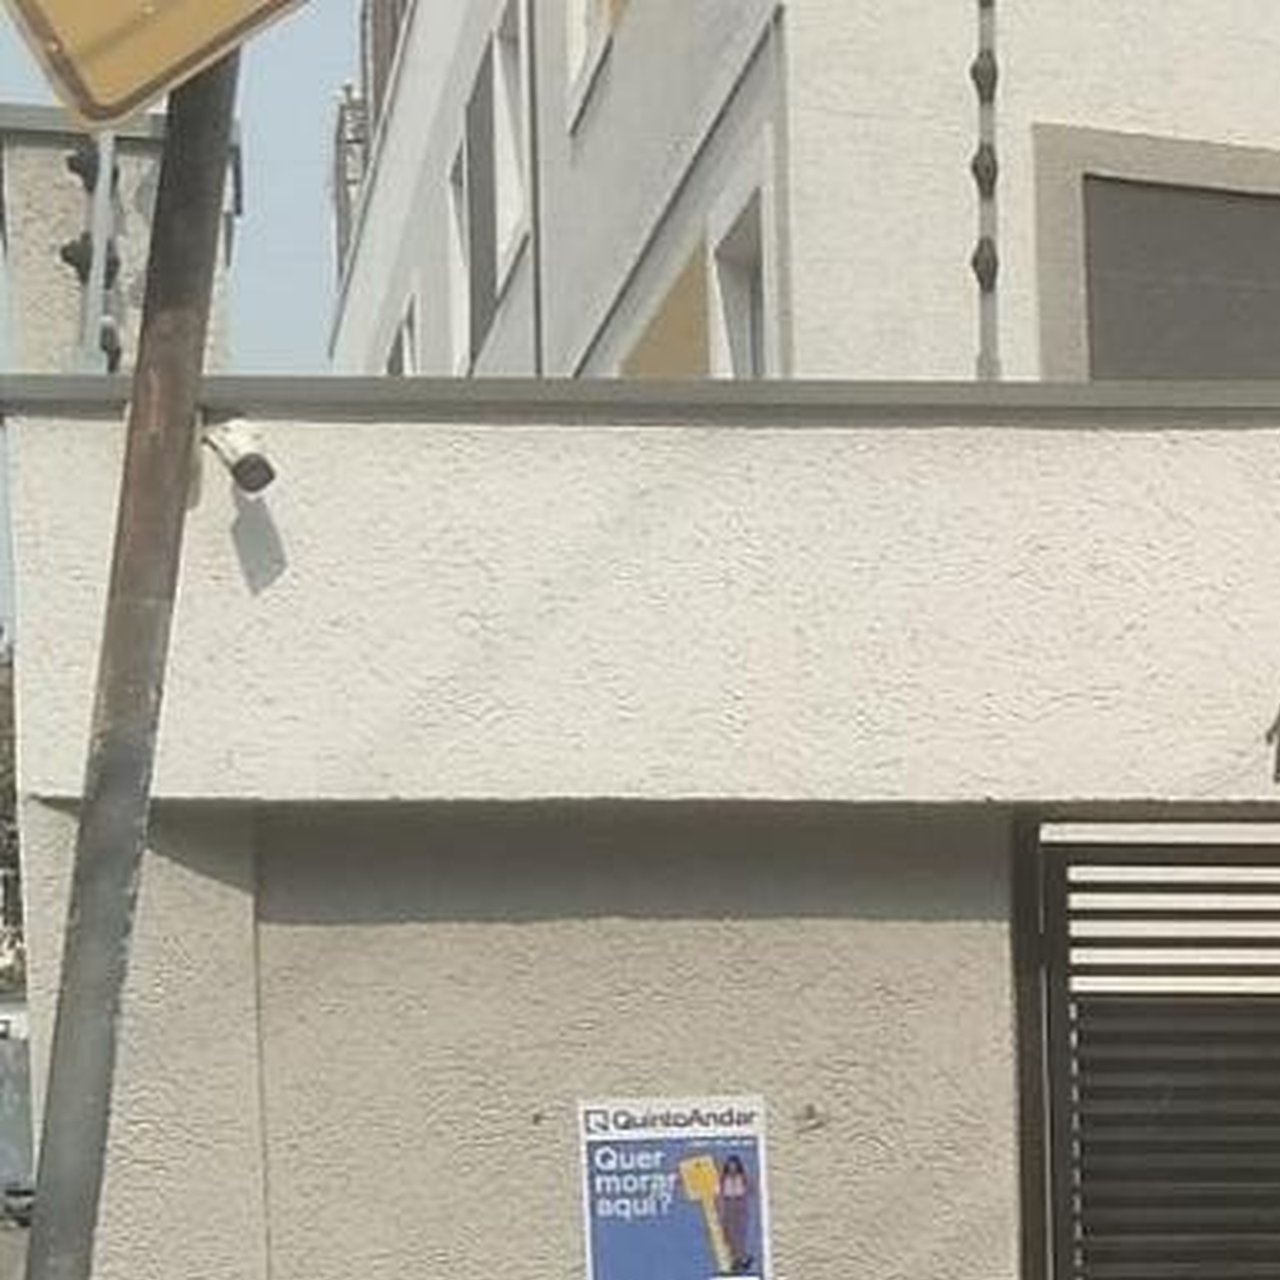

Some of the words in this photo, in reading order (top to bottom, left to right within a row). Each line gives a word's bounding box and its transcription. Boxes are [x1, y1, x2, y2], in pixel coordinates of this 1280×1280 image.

[612, 1107, 757, 1129] QuintoAndar
[594, 1146, 665, 1171] Quer
[595, 1173, 677, 1194] morar
[596, 1193, 673, 1220] aqui?
